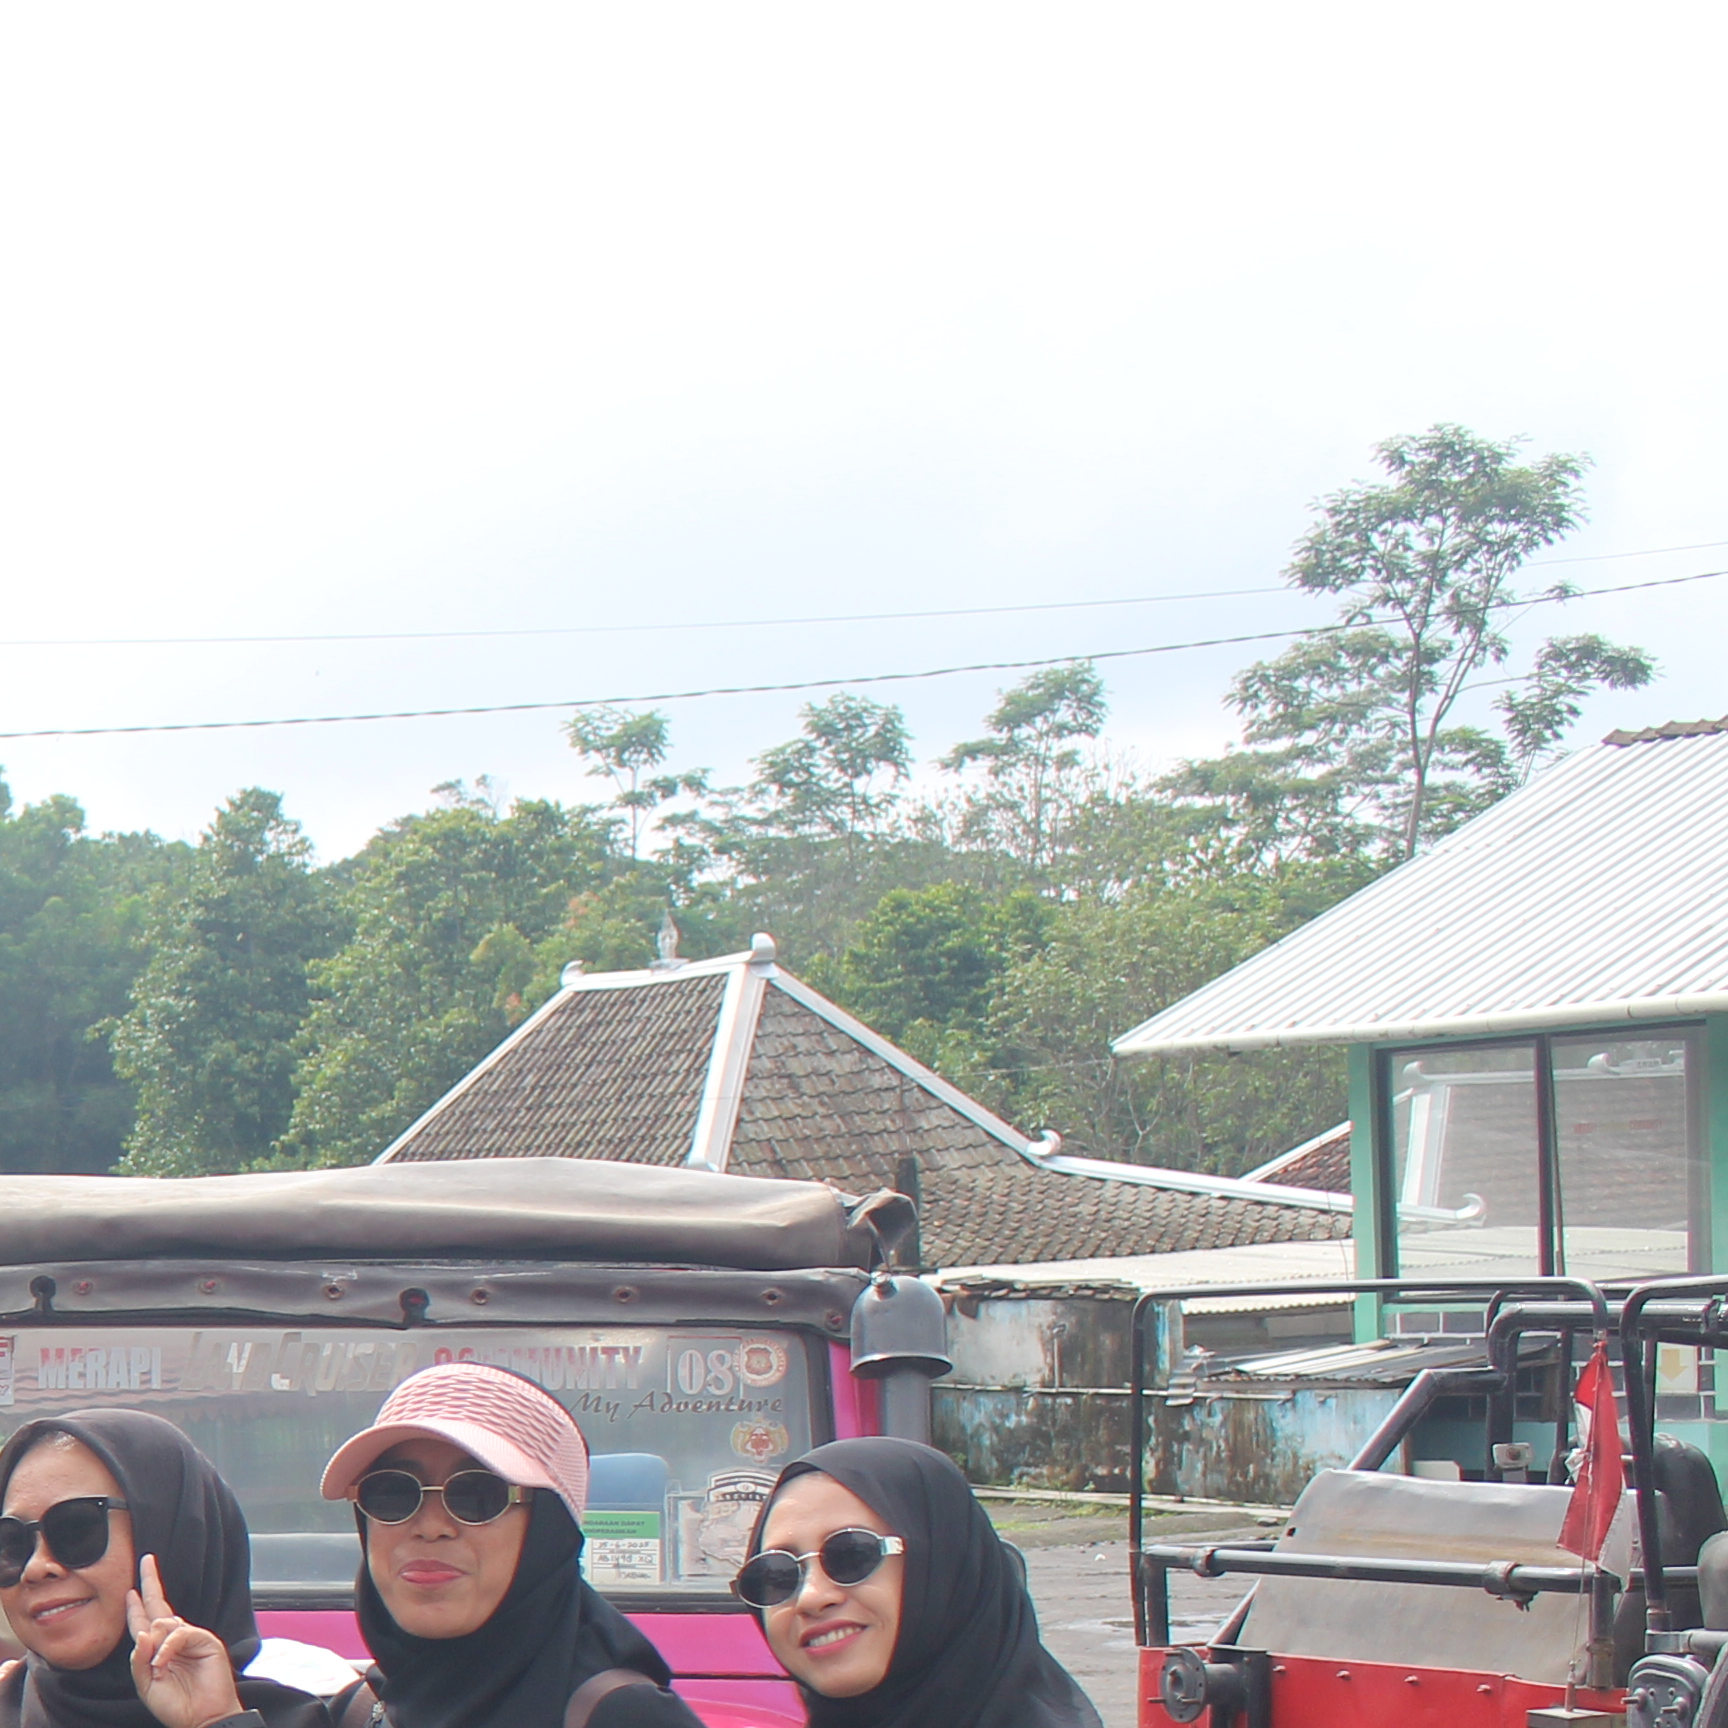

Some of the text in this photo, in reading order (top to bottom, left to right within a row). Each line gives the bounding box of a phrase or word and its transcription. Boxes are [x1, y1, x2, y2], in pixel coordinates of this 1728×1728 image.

[38, 1347, 162, 1389] MERAPI
[677, 1349, 734, 1396] 08
[570, 1391, 784, 1422] My Adventure
